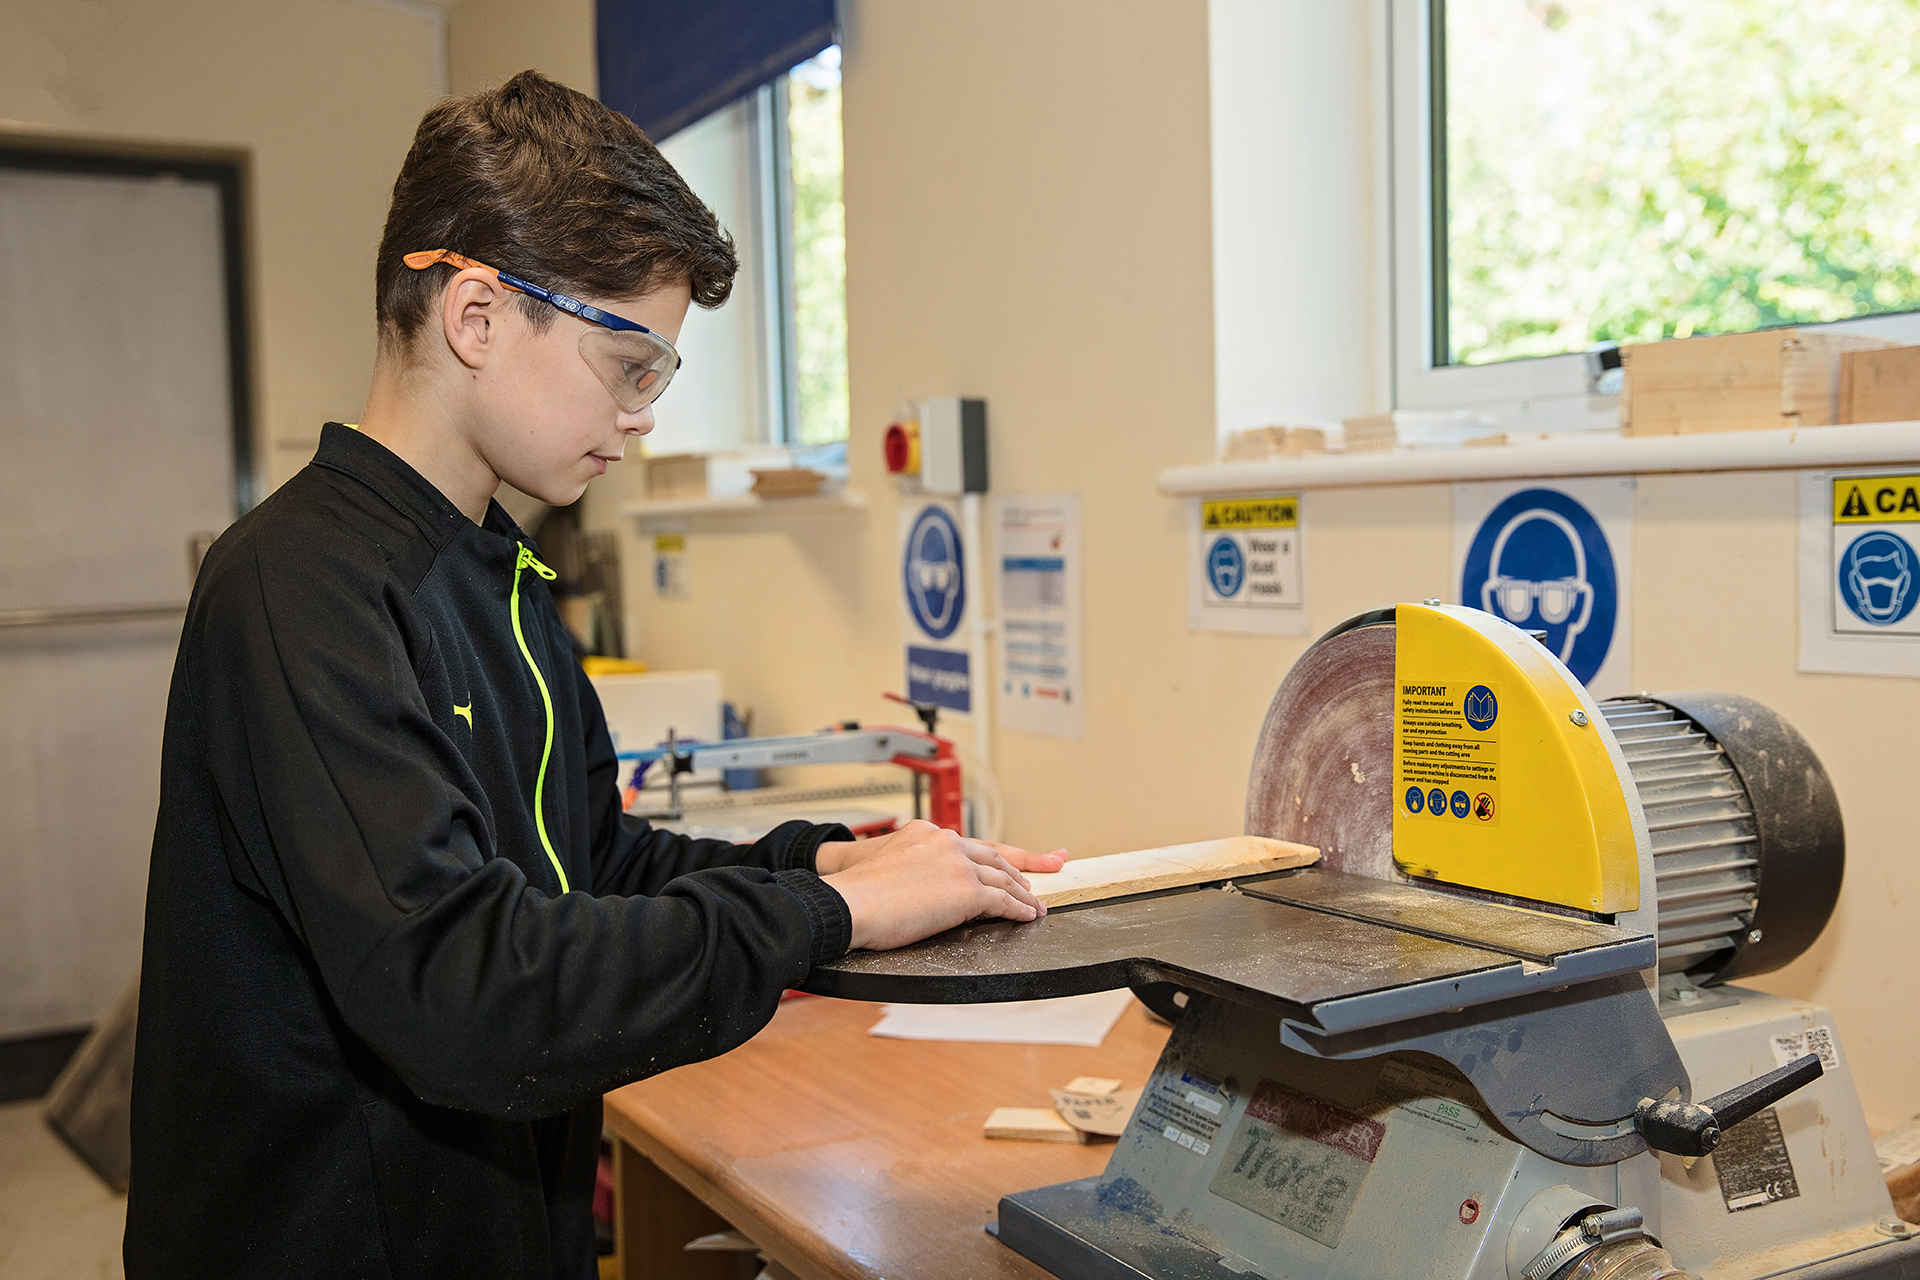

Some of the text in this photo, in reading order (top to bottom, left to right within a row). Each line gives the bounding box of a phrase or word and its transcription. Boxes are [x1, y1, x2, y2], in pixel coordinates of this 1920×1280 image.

[1223, 505, 1294, 523] CAUTION
[1403, 686, 1446, 696] IMPORTANT
[1437, 1103, 1460, 1118] PASS
[1233, 1126, 1348, 1214] Trade
